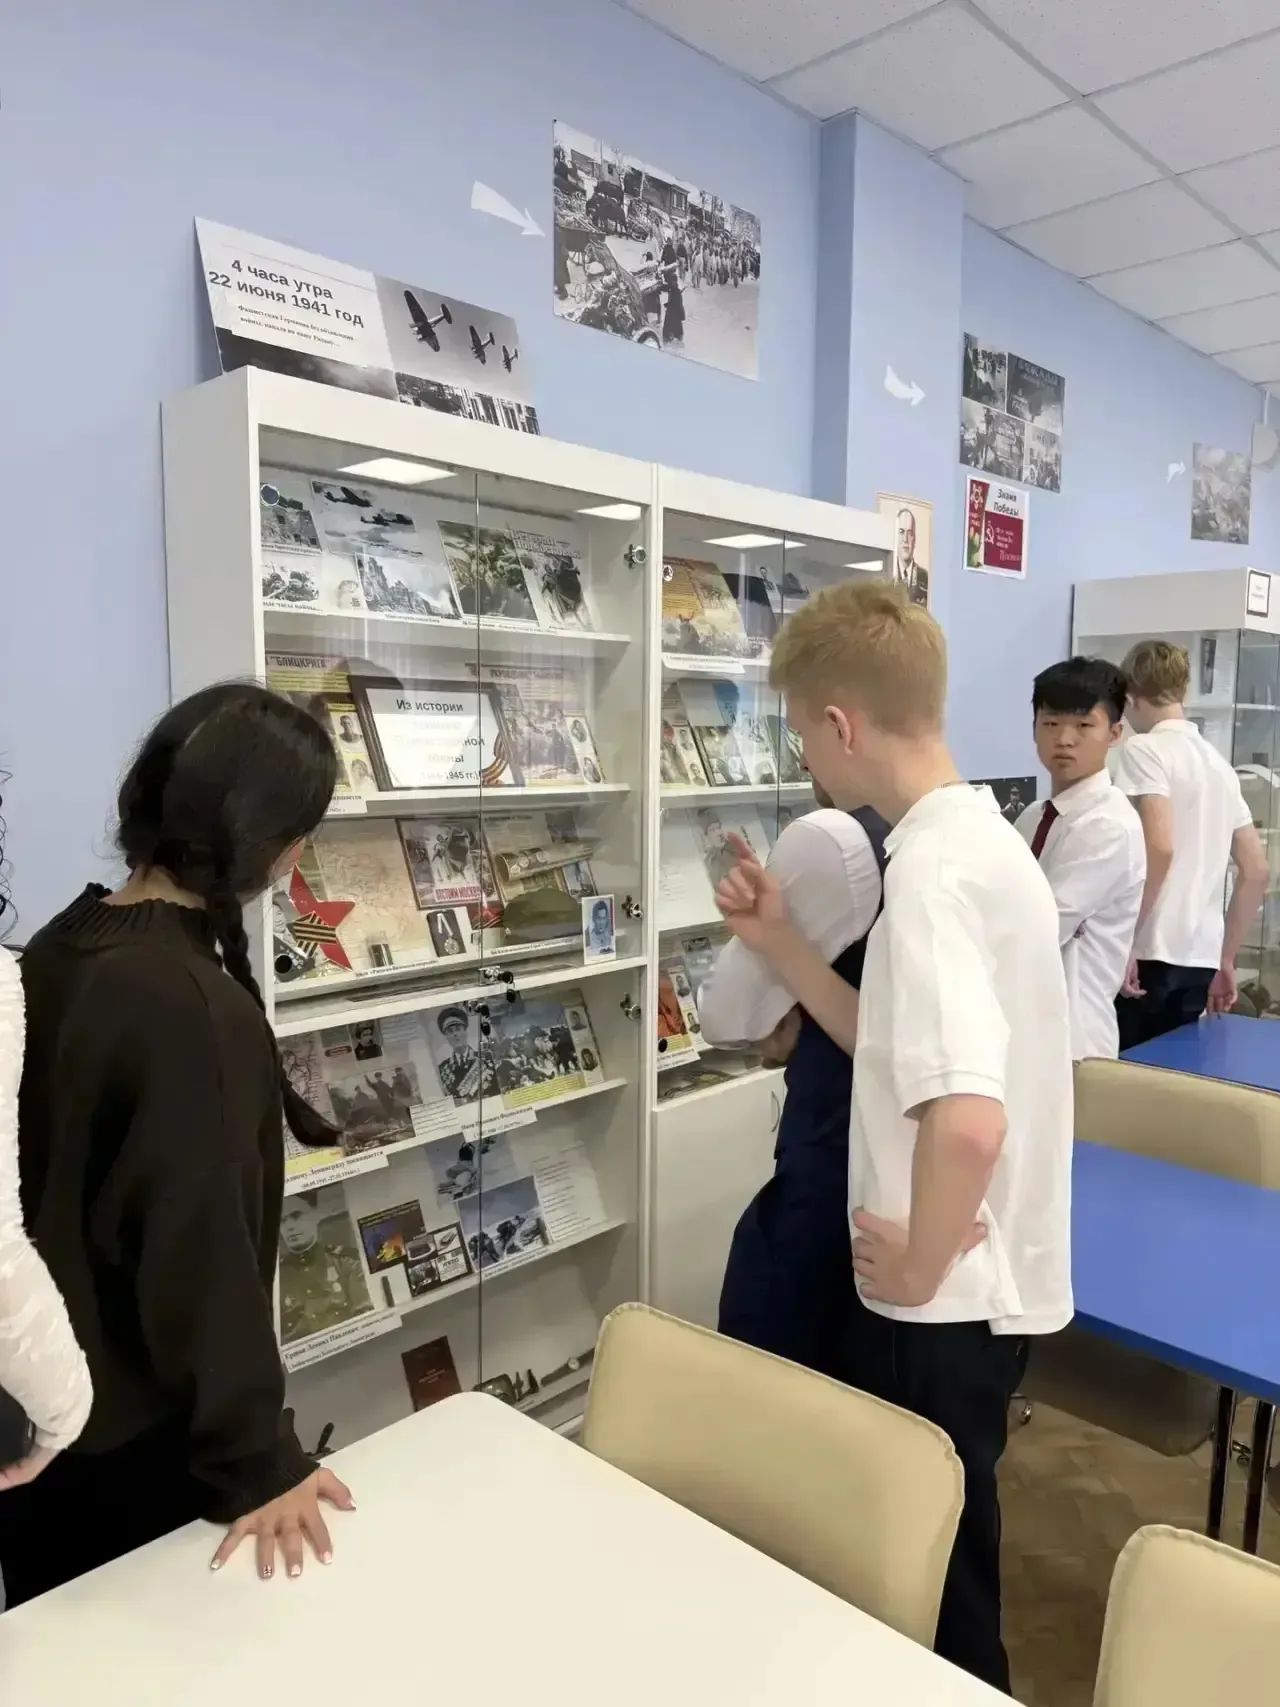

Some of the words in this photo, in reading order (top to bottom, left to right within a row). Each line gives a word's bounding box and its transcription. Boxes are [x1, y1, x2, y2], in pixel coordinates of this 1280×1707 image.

[231, 259, 243, 273] 4
[247, 264, 290, 287] часа
[293, 278, 334, 300] утра
[208, 271, 232, 288] 22
[237, 281, 286, 303] июня
[291, 295, 331, 317] 1941
[335, 309, 364, 328] год
[997, 488, 1017, 502] Знамя
[993, 502, 1019, 516] Победы
[396, 699, 412, 710] Из
[415, 702, 464, 713] истории
